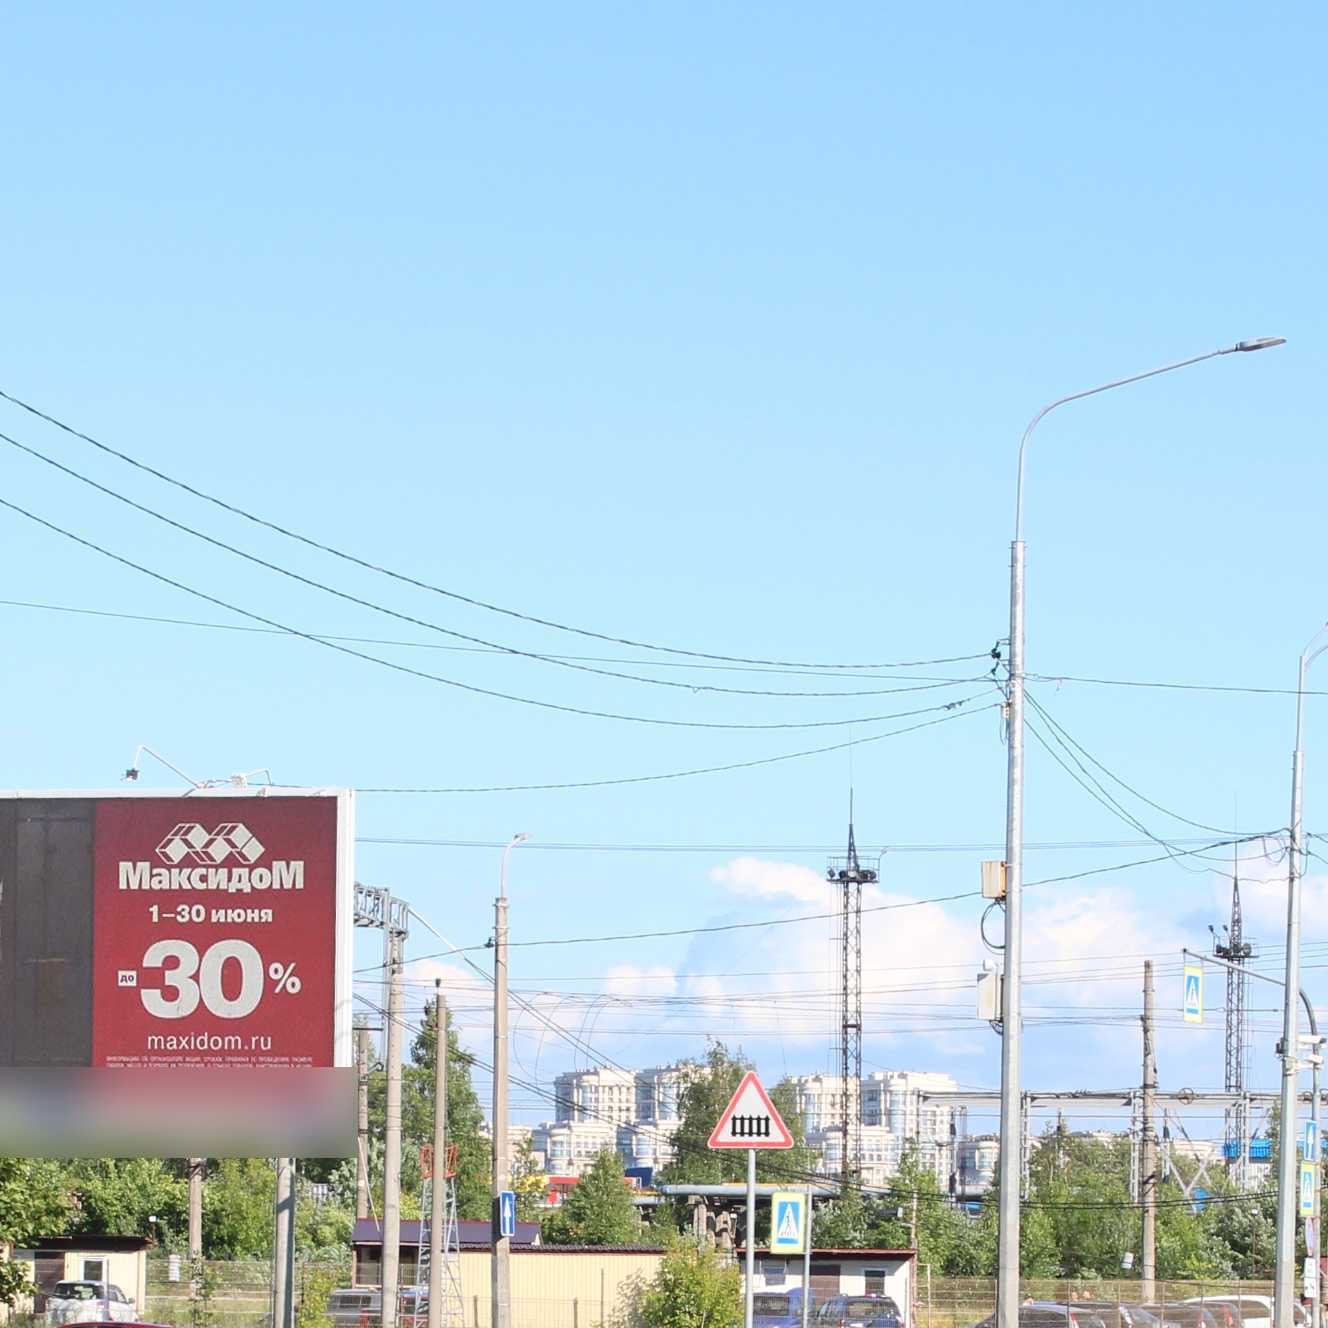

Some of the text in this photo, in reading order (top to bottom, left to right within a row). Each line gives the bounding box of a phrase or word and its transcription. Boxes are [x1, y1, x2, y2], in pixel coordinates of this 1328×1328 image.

[211, 909, 273, 923] июня
[119, 974, 135, 984] до
[147, 1032, 272, 1050] maxidom.ru
